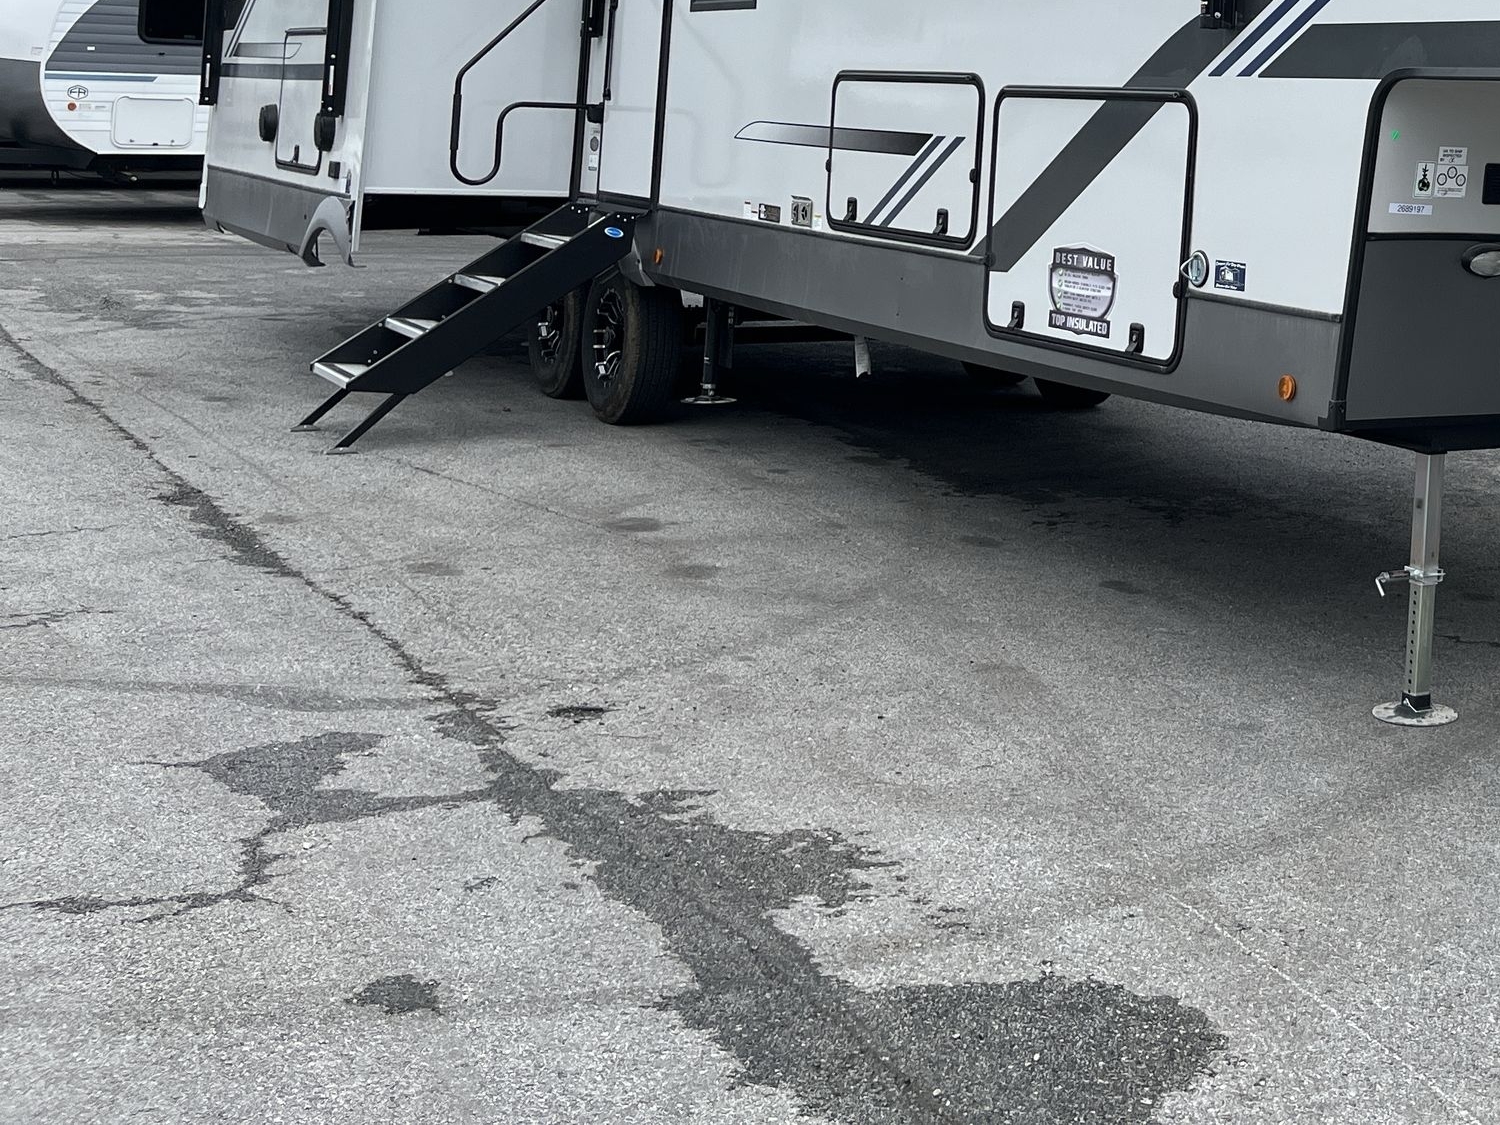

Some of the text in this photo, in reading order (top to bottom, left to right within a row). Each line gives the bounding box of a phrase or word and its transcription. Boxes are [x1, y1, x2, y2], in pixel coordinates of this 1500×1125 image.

[1055, 252, 1112, 271] BEST VALUE
[1051, 314, 1108, 334] TOP INSULATED
